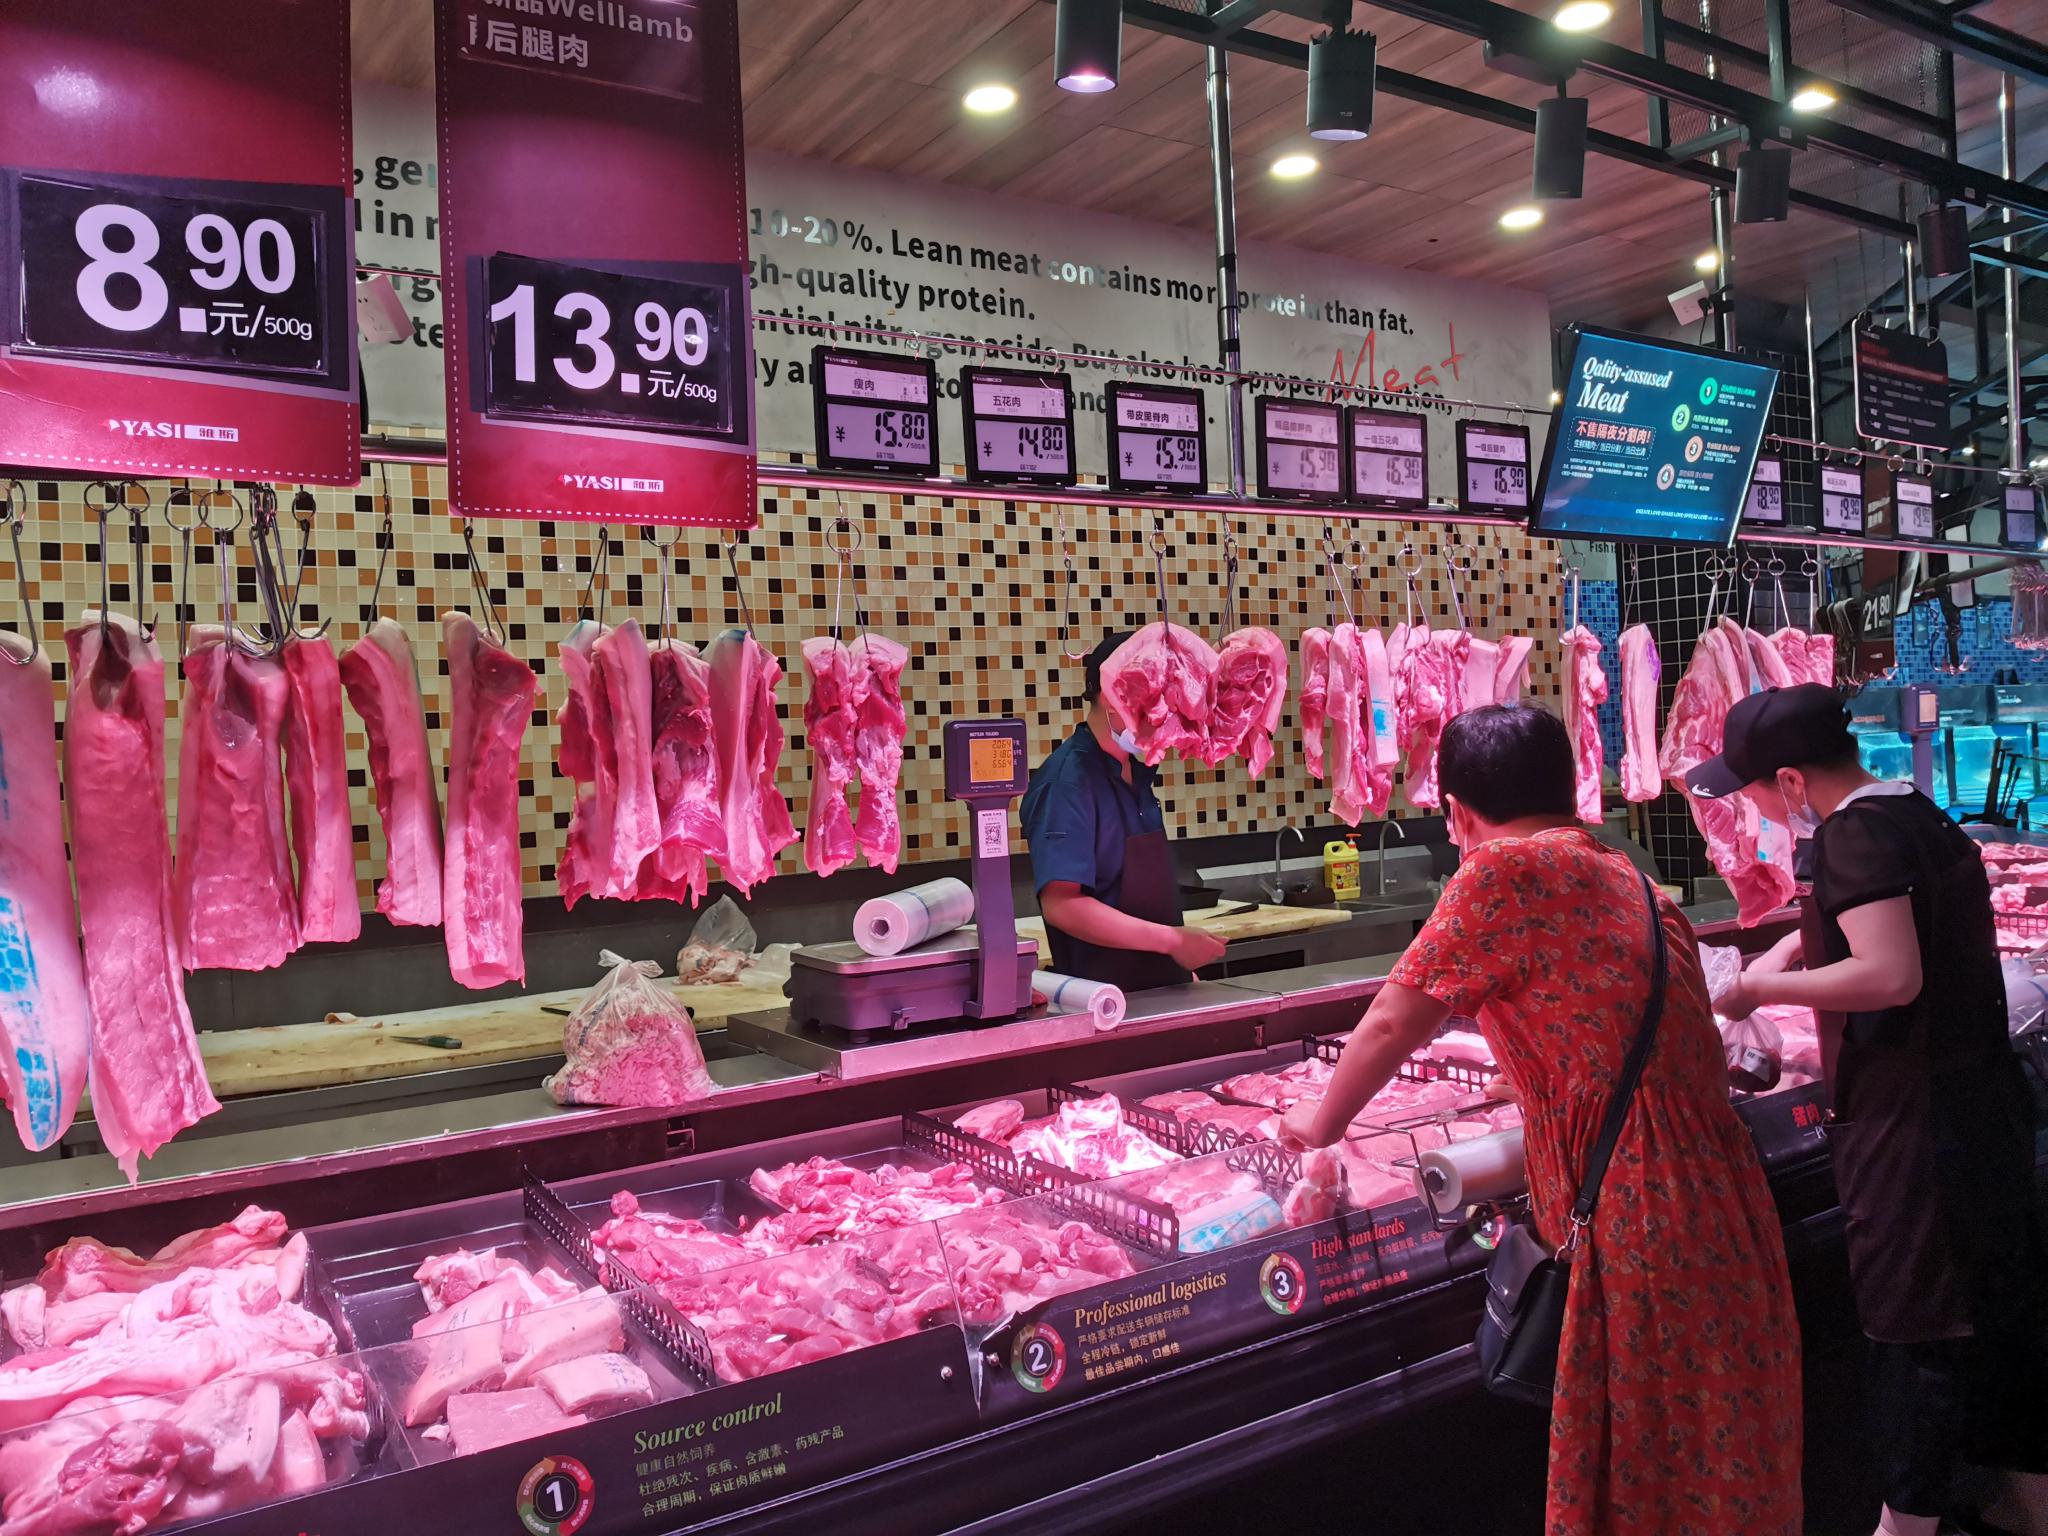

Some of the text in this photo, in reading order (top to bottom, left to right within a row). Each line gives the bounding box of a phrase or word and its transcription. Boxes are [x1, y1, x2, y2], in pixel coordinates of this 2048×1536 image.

[75, 203, 296, 333] 8.90
[891, 228, 963, 266] Lean
[970, 251, 1042, 277] meat
[1047, 259, 1161, 297] contains
[1166, 279, 1217, 305] mor
[1238, 287, 1321, 321] protein
[1325, 300, 1374, 329] than
[1378, 308, 1415, 336] fat.
[919, 283, 1036, 321] protein.
[209, 301, 313, 341] 元/500g
[490, 284, 709, 393] 13.90
[1126, 350, 1178, 379] also
[1325, 320, 1466, 403] Meat
[647, 369, 718, 403] 元/500g
[853, 377, 875, 392] 瘦肉
[992, 394, 1022, 408] 五花肉
[1576, 380, 1630, 415] Meat
[122, 420, 181, 439] YASI
[875, 411, 925, 448] 15.80
[1018, 426, 1063, 460] 14.80
[1156, 436, 1196, 470] 15.90
[573, 474, 620, 490] YASI
[1494, 467, 1524, 494] 16.90
[1274, 1270, 1289, 1296] 3
[1311, 1235, 1343, 1260] High
[1028, 1343, 1048, 1372] 2
[1073, 1284, 1167, 1329] Professional
[1170, 1271, 1228, 1303] logistics
[545, 1480, 563, 1512] 1
[633, 1418, 706, 1455] Source
[711, 1392, 783, 1433] control
